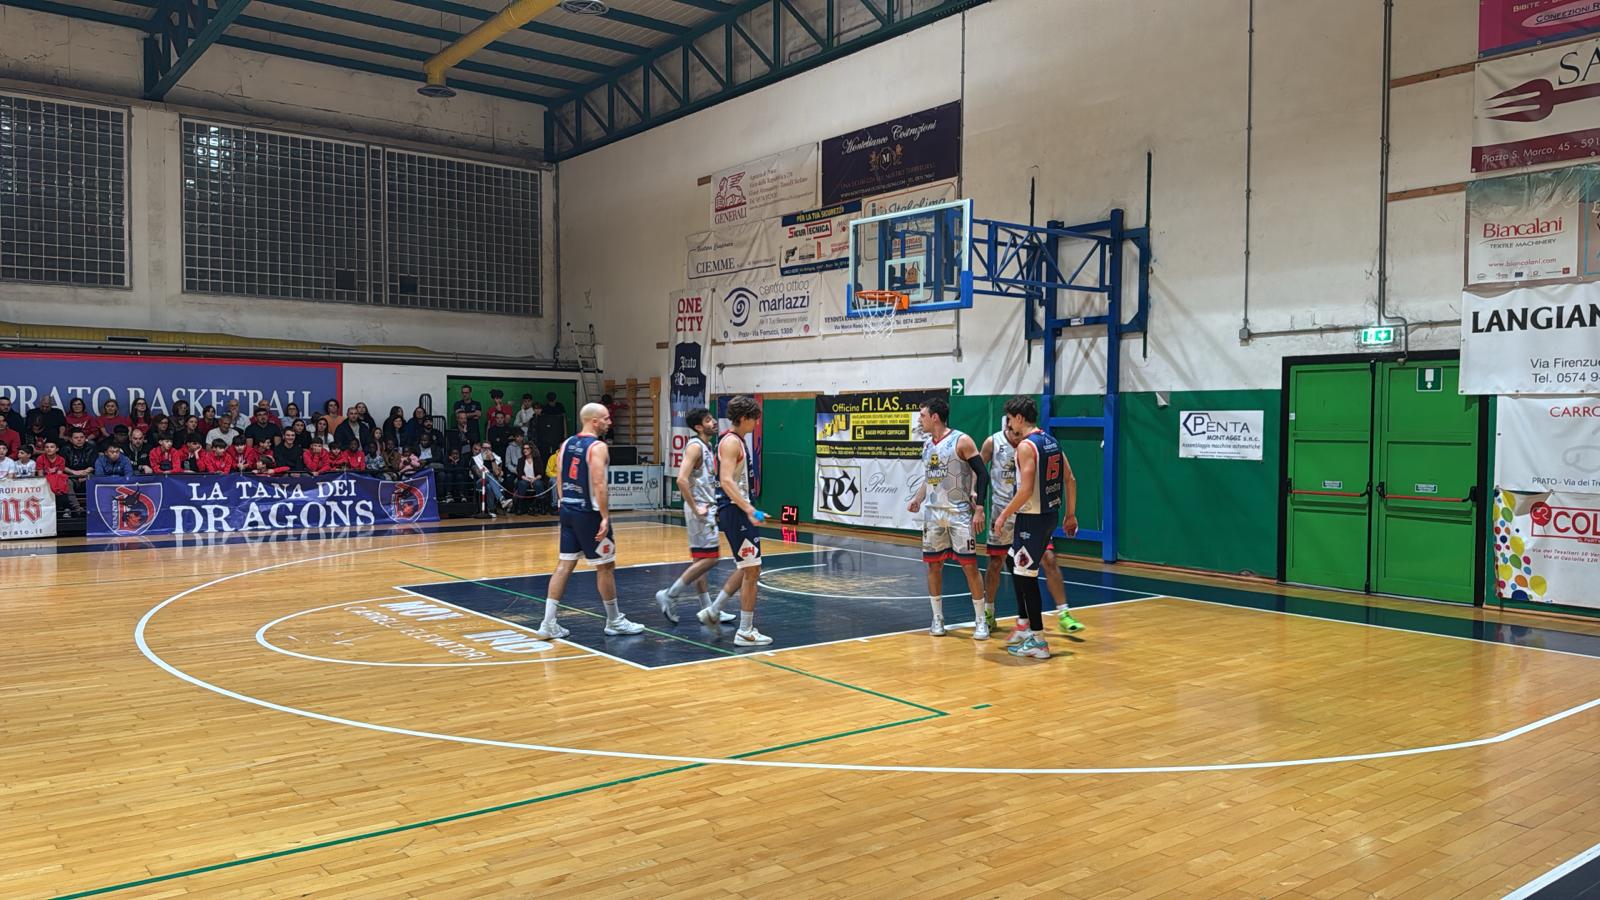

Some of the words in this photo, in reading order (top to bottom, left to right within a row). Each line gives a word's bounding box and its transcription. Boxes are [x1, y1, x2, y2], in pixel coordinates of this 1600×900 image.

[1513, 1, 1540, 13] BIBITE
[1536, 5, 1590, 23] CONFEZIONI
[1481, 152, 1509, 163] Piazza
[1511, 150, 1520, 160] S.
[1523, 146, 1556, 158] Marco,
[1558, 143, 1570, 152] 45
[714, 207, 748, 225] GENERALI
[1483, 217, 1564, 239] Biancalani
[1515, 239, 1557, 248] MACHINERY
[696, 257, 736, 274] CIEMME
[1488, 257, 1557, 268] www.biancalani.com
[759, 281, 785, 296] centro
[677, 297, 702, 314] ONE
[759, 291, 811, 313] marlazzi
[675, 316, 704, 333] CITY
[1530, 358, 1550, 369] Via
[1532, 373, 1552, 384] Tel.
[1556, 372, 1586, 383] 0574
[127, 387, 312, 420] BASKETBALL
[832, 403, 860, 413] Officina
[861, 397, 903, 412] FI.LAS.
[1193, 416, 1251, 434] PENTA
[188, 482, 228, 501] LA
[236, 481, 305, 500] TANA
[317, 479, 357, 498] DEI
[864, 472, 898, 495] Piana
[1532, 476, 1558, 485] PRATO
[1563, 478, 1576, 487] Via
[1577, 478, 1590, 487] dei
[169, 499, 375, 535] DRAGONS
[782, 507, 798, 522] 24
